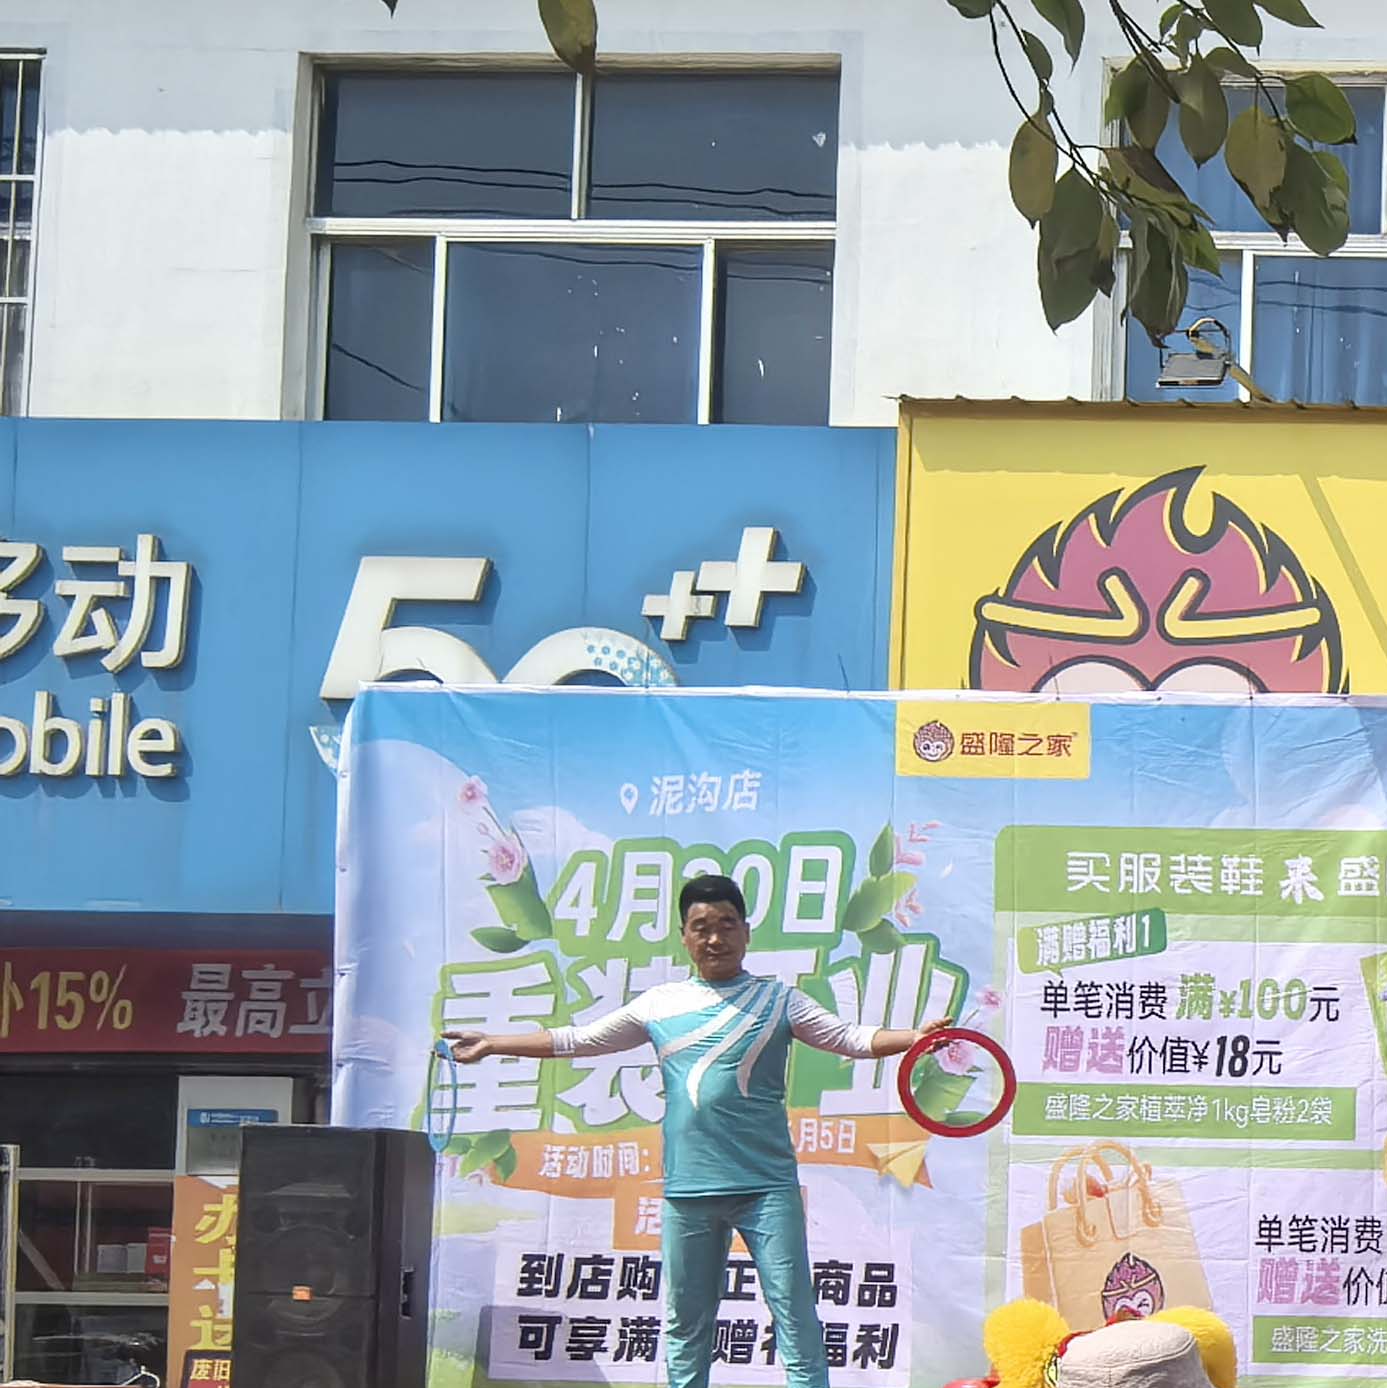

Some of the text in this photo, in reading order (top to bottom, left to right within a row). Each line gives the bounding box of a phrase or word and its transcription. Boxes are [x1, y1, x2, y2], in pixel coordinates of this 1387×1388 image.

[960, 731, 1073, 757] 盛隆之家
[650, 770, 762, 813] 泥沟店
[555, 844, 843, 943] 4月0日
[1065, 852, 1265, 898] 买服装鞋
[1041, 980, 1168, 1021] 单笔消费
[1255, 1213, 1384, 1255] 单笔消费
